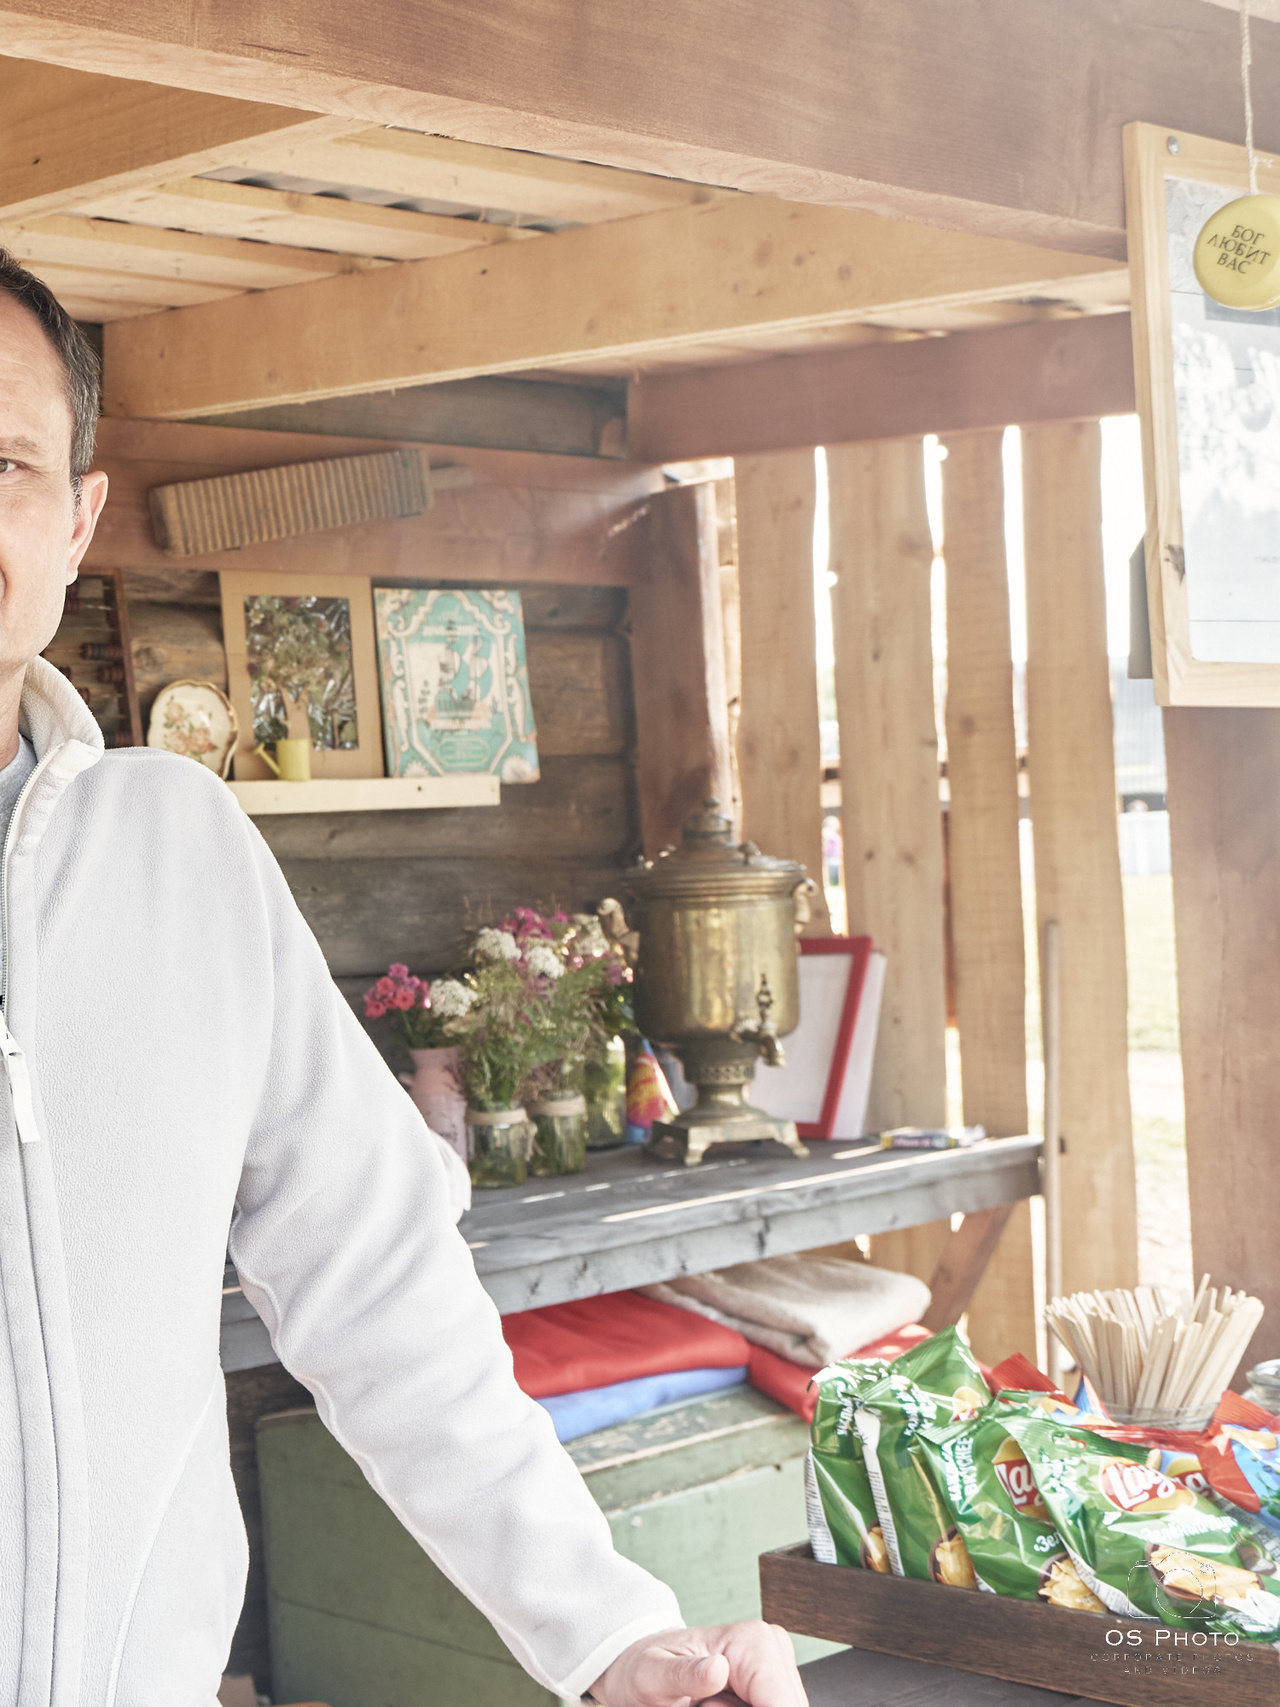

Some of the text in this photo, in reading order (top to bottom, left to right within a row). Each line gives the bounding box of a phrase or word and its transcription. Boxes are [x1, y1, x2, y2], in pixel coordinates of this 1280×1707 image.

[1231, 224, 1265, 245] БОГ
[1207, 233, 1271, 265] ЛЮБИТ
[1217, 252, 1251, 274] ВАС
